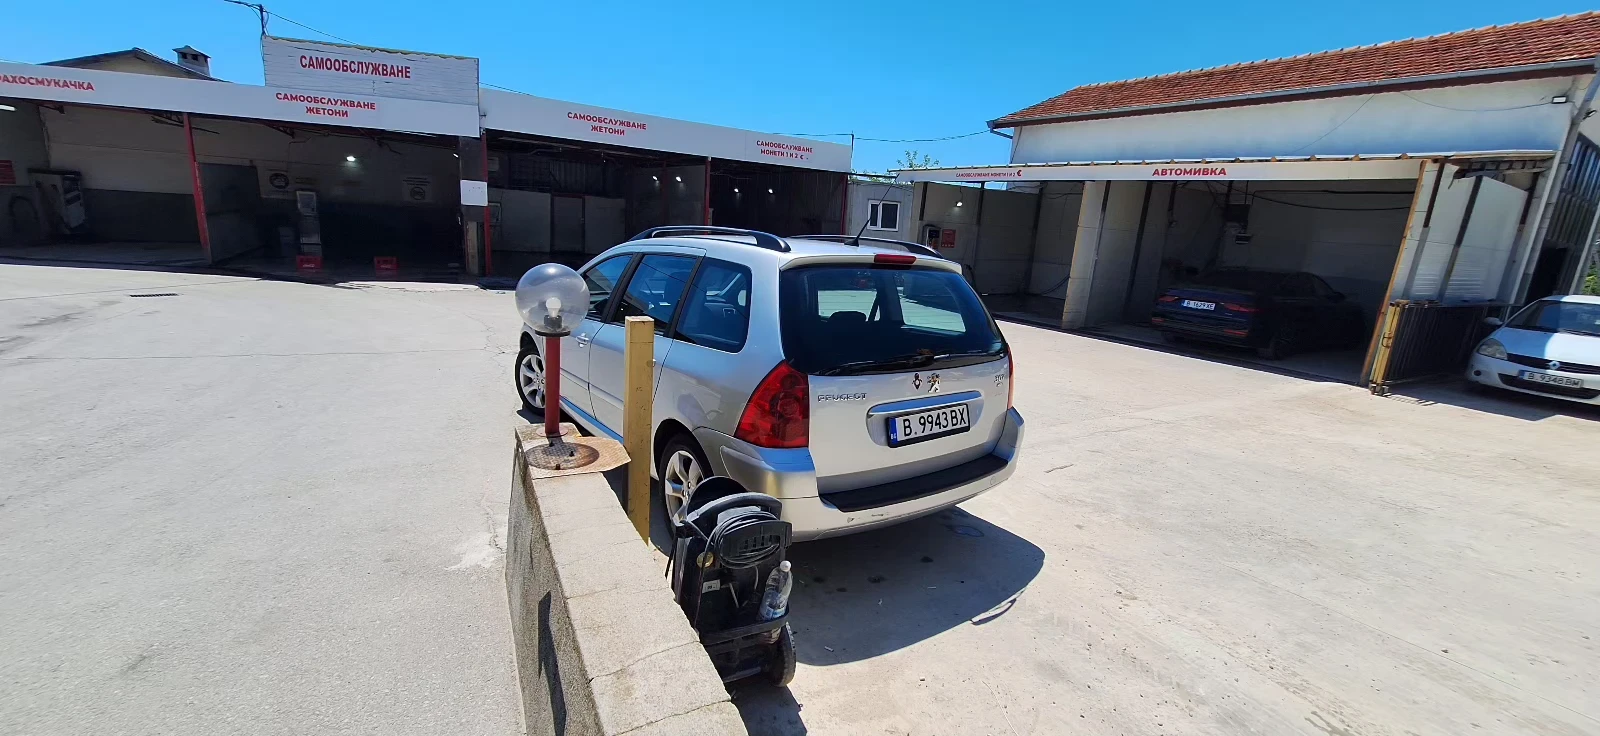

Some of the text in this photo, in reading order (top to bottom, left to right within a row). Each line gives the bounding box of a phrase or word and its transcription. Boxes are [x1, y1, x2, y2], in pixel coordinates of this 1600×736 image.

[299, 55, 411, 78] САМООБСЛУЖВАНЕ
[275, 92, 376, 110] САМООБСЛУЖВАНЕ
[305, 106, 349, 118] ЖЕТОНИ
[567, 112, 647, 130] САМООБСЛУЖВАНЕ
[591, 125, 625, 136] ЖЕТОНИ
[756, 140, 813, 153] САМООБСЛУЖВАНЕ
[760, 149, 785, 157] МОНЕТИ
[1016, 169, 1022, 177] €
[1152, 167, 1227, 176] АВТОМИВКА
[817, 392, 868, 402] PEUGEOT
